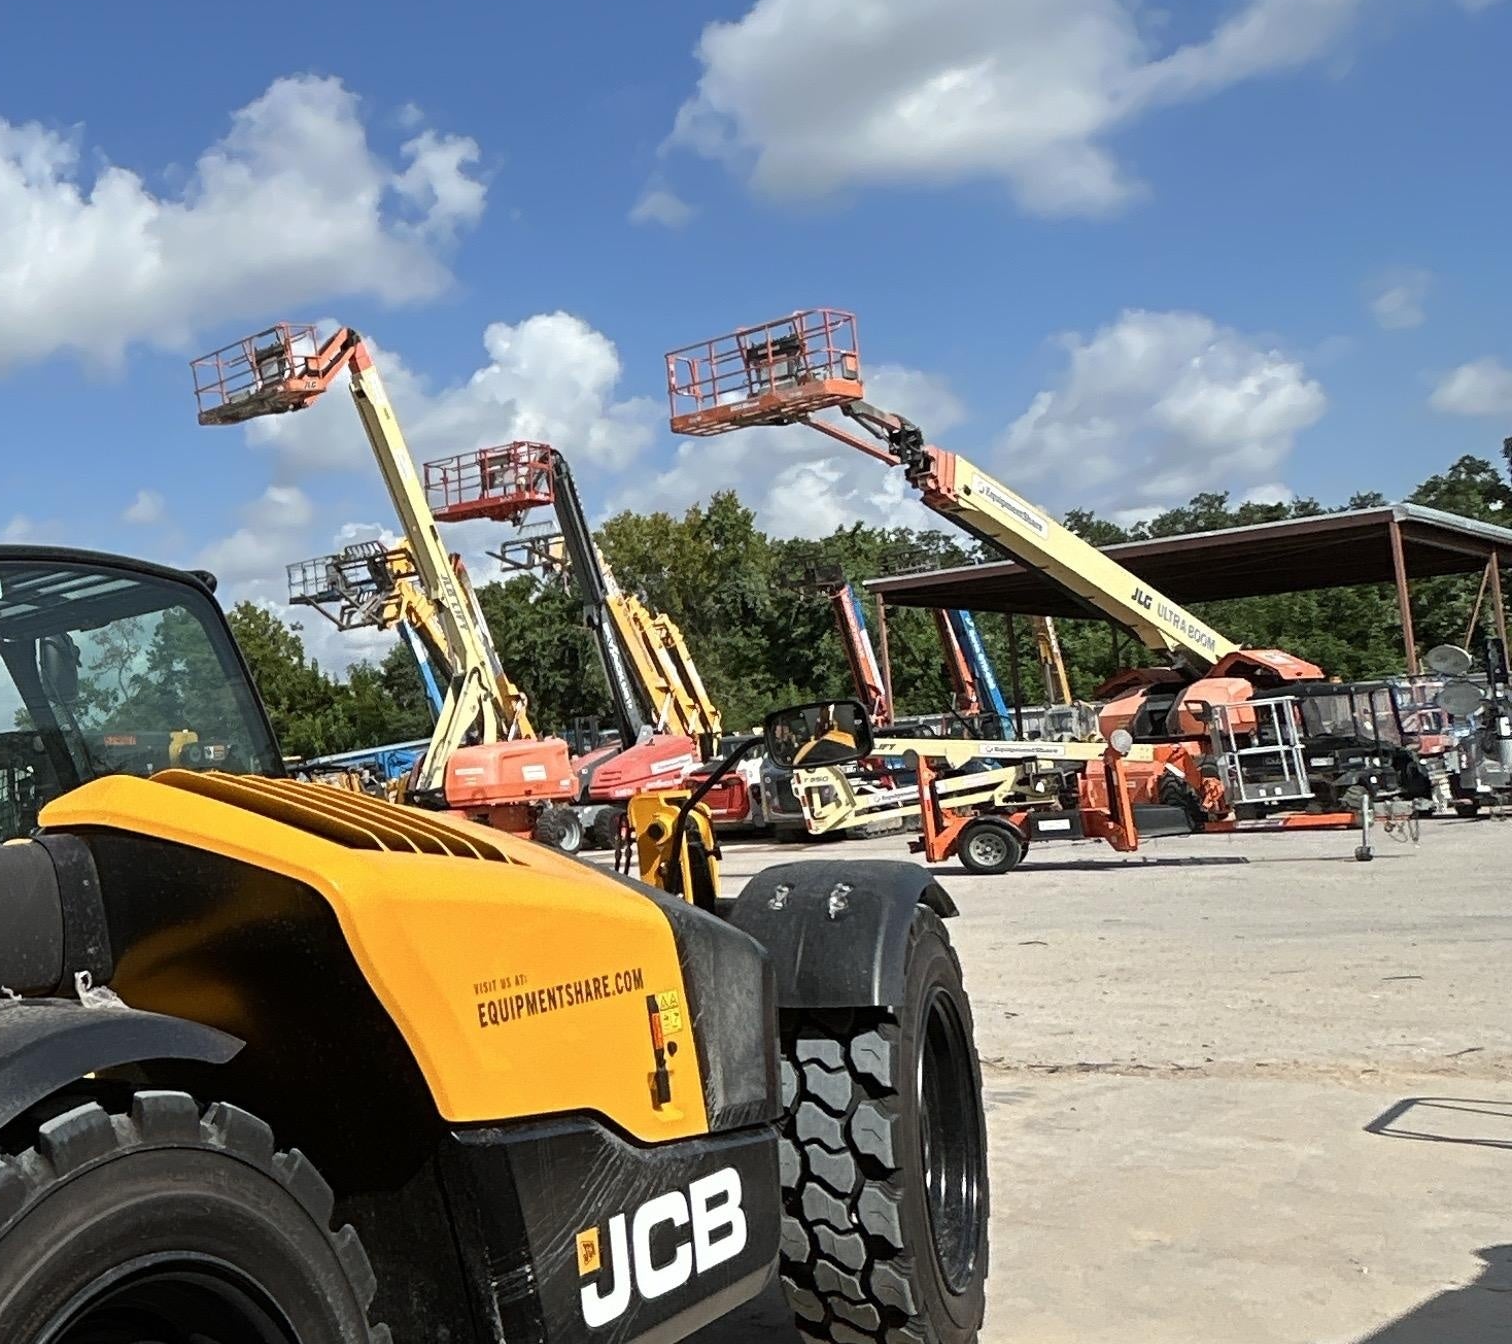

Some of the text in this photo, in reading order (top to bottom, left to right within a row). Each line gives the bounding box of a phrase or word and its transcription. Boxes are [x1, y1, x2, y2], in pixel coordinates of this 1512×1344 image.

[1131, 587, 1216, 652] JLG ULTRA BOOM
[473, 979, 497, 995] VISIT
[500, 976, 512, 989] US
[478, 968, 644, 1028] EQUIPMENTSHARE.COM
[580, 1167, 747, 1327] JCB
